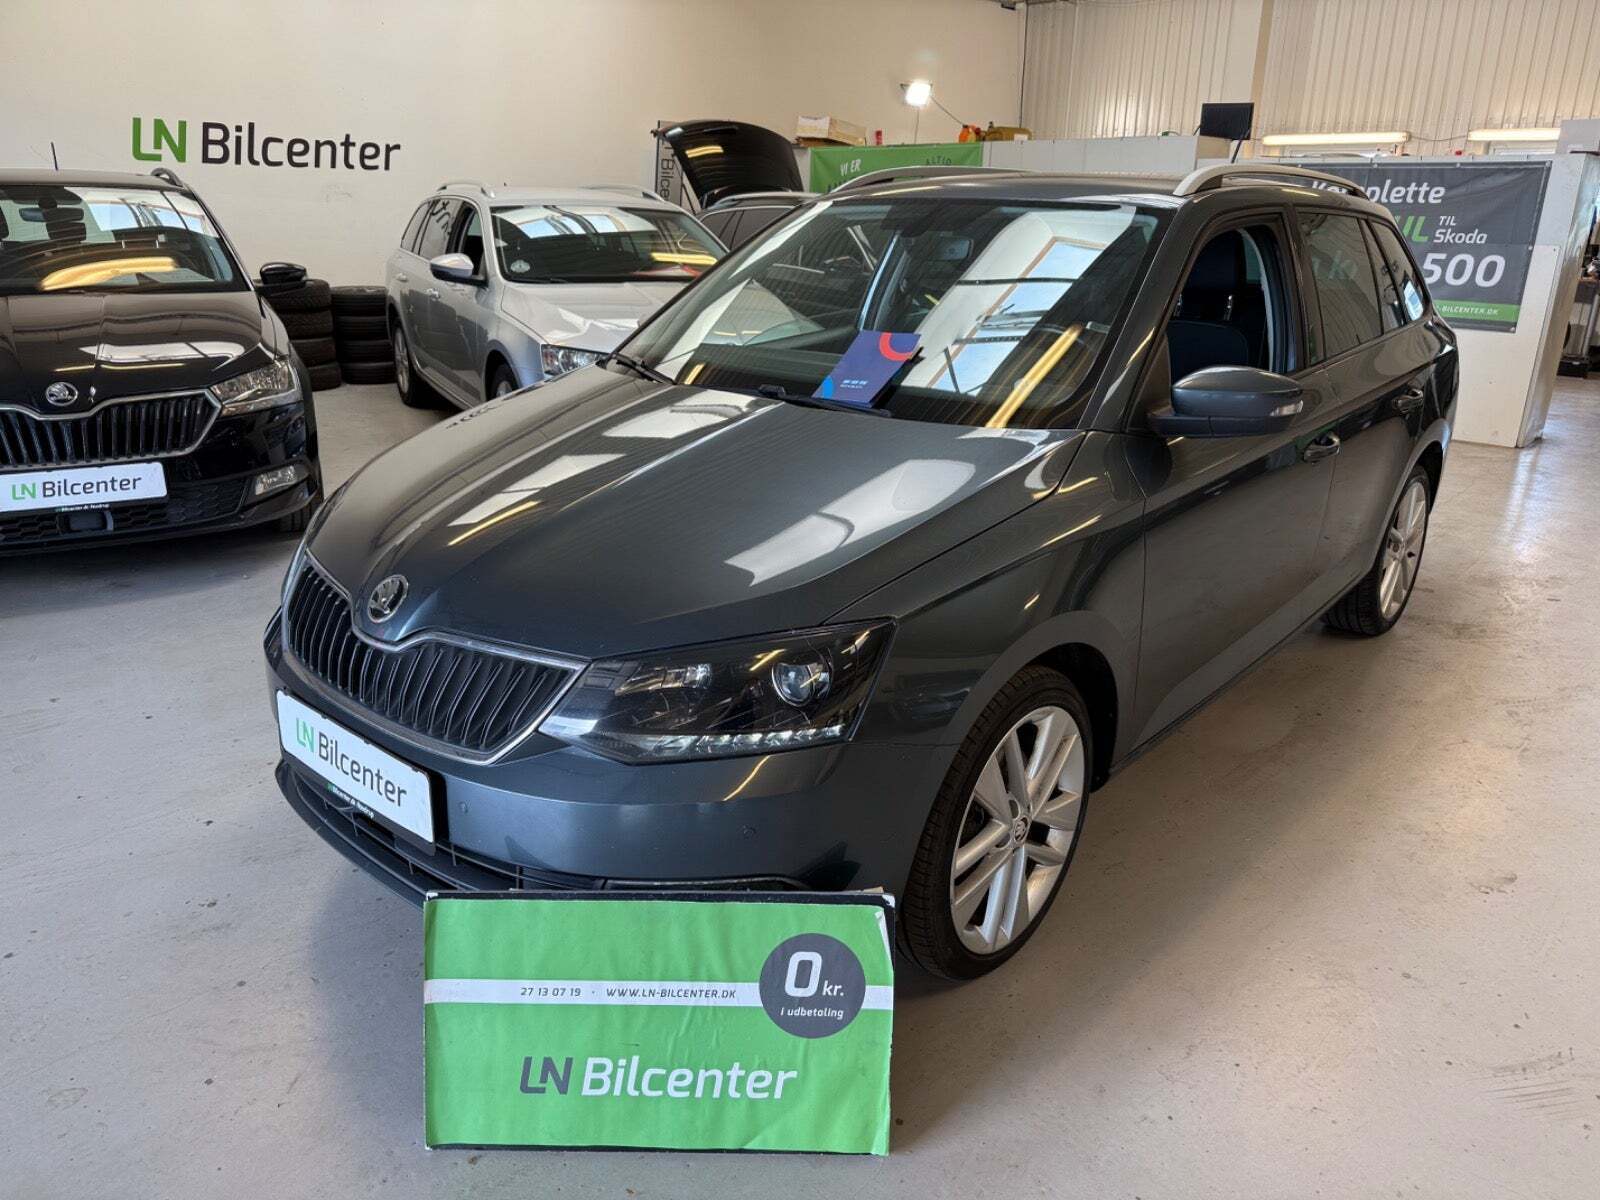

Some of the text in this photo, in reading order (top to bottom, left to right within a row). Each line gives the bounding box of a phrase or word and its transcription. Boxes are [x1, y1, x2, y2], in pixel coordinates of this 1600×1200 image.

[132, 117, 401, 171] LN Bilcenter
[660, 158, 675, 200] Bilce
[1433, 228, 1488, 244] Skoda
[1440, 215, 1457, 226] TIL
[11, 476, 142, 500] LN Bilcenter
[296, 718, 314, 753] LN
[318, 731, 407, 807] Bilcenter
[784, 951, 844, 998] 0 kr.
[520, 987, 736, 999] 27 13 07 19 WWW.LN-BILCENTER.DK
[787, 1007, 845, 1020] udbetaling
[519, 1055, 798, 1100] LN Bilcenter
